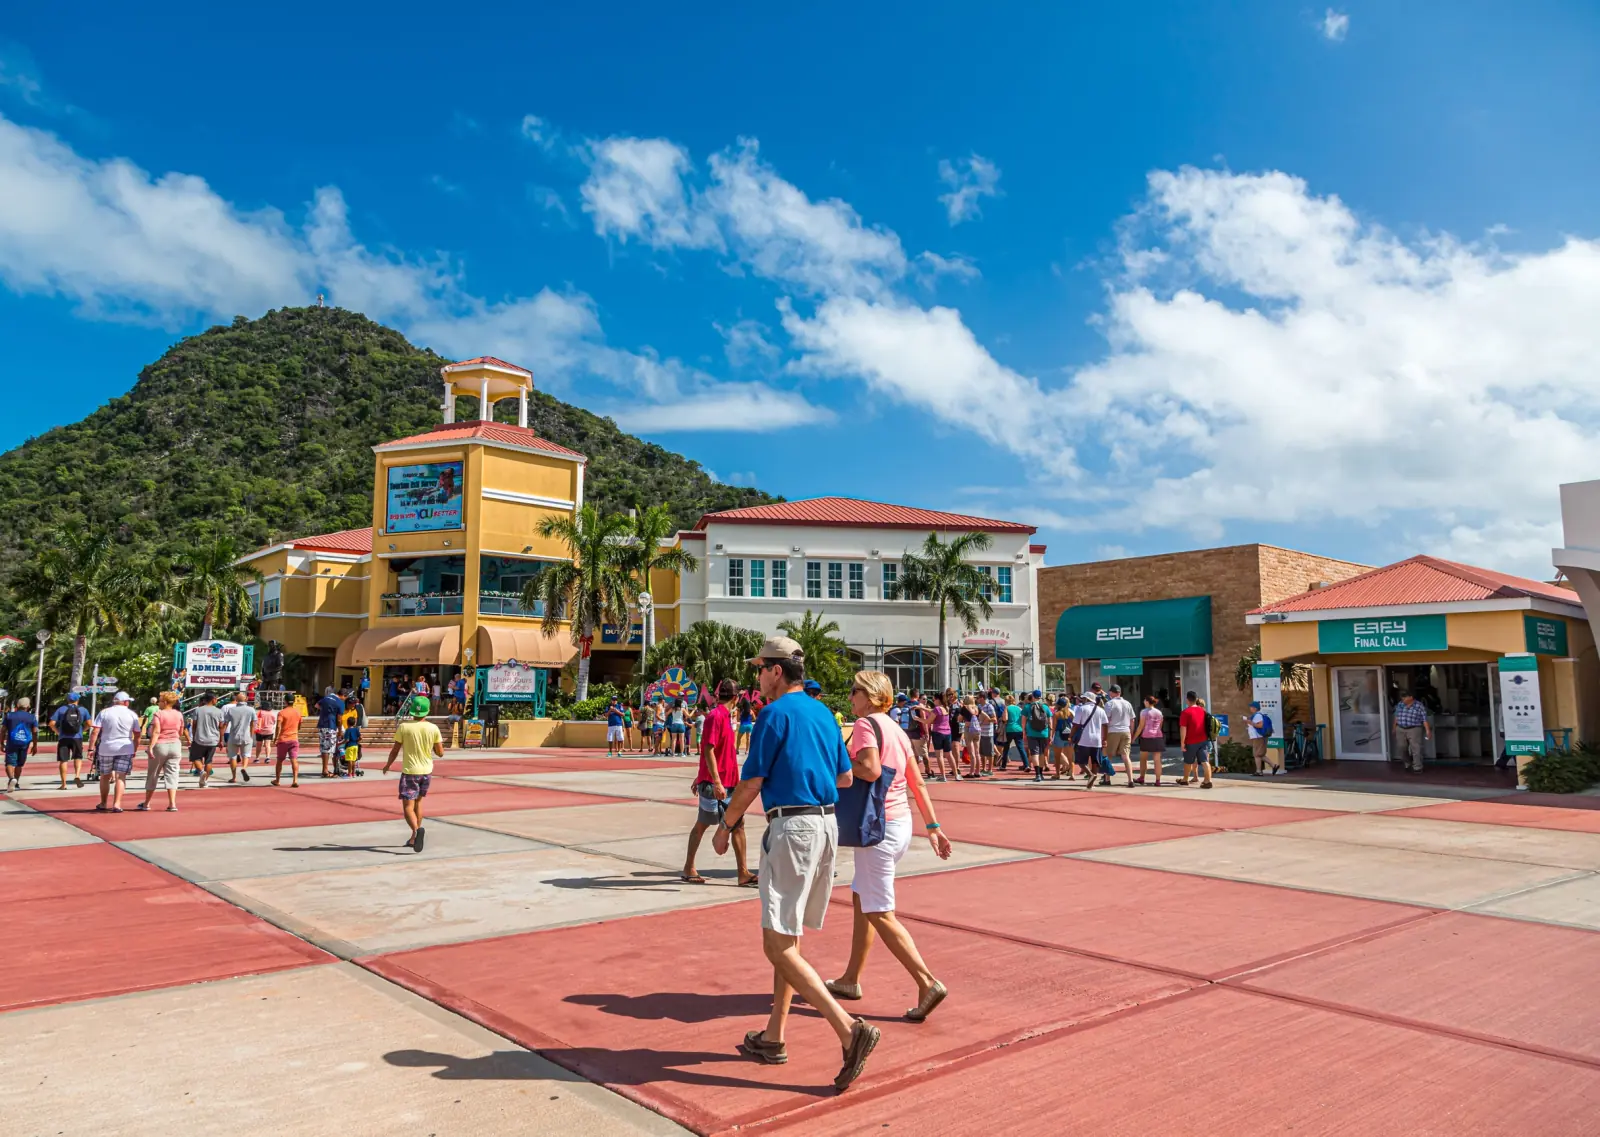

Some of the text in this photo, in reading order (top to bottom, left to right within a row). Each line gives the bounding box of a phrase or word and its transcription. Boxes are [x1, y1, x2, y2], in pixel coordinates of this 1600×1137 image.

[1096, 626, 1144, 641] EFFY
[1354, 621, 1407, 634] EFFY
[980, 628, 1010, 640] RENTAL
[1354, 636, 1408, 647] FINAL CALL
